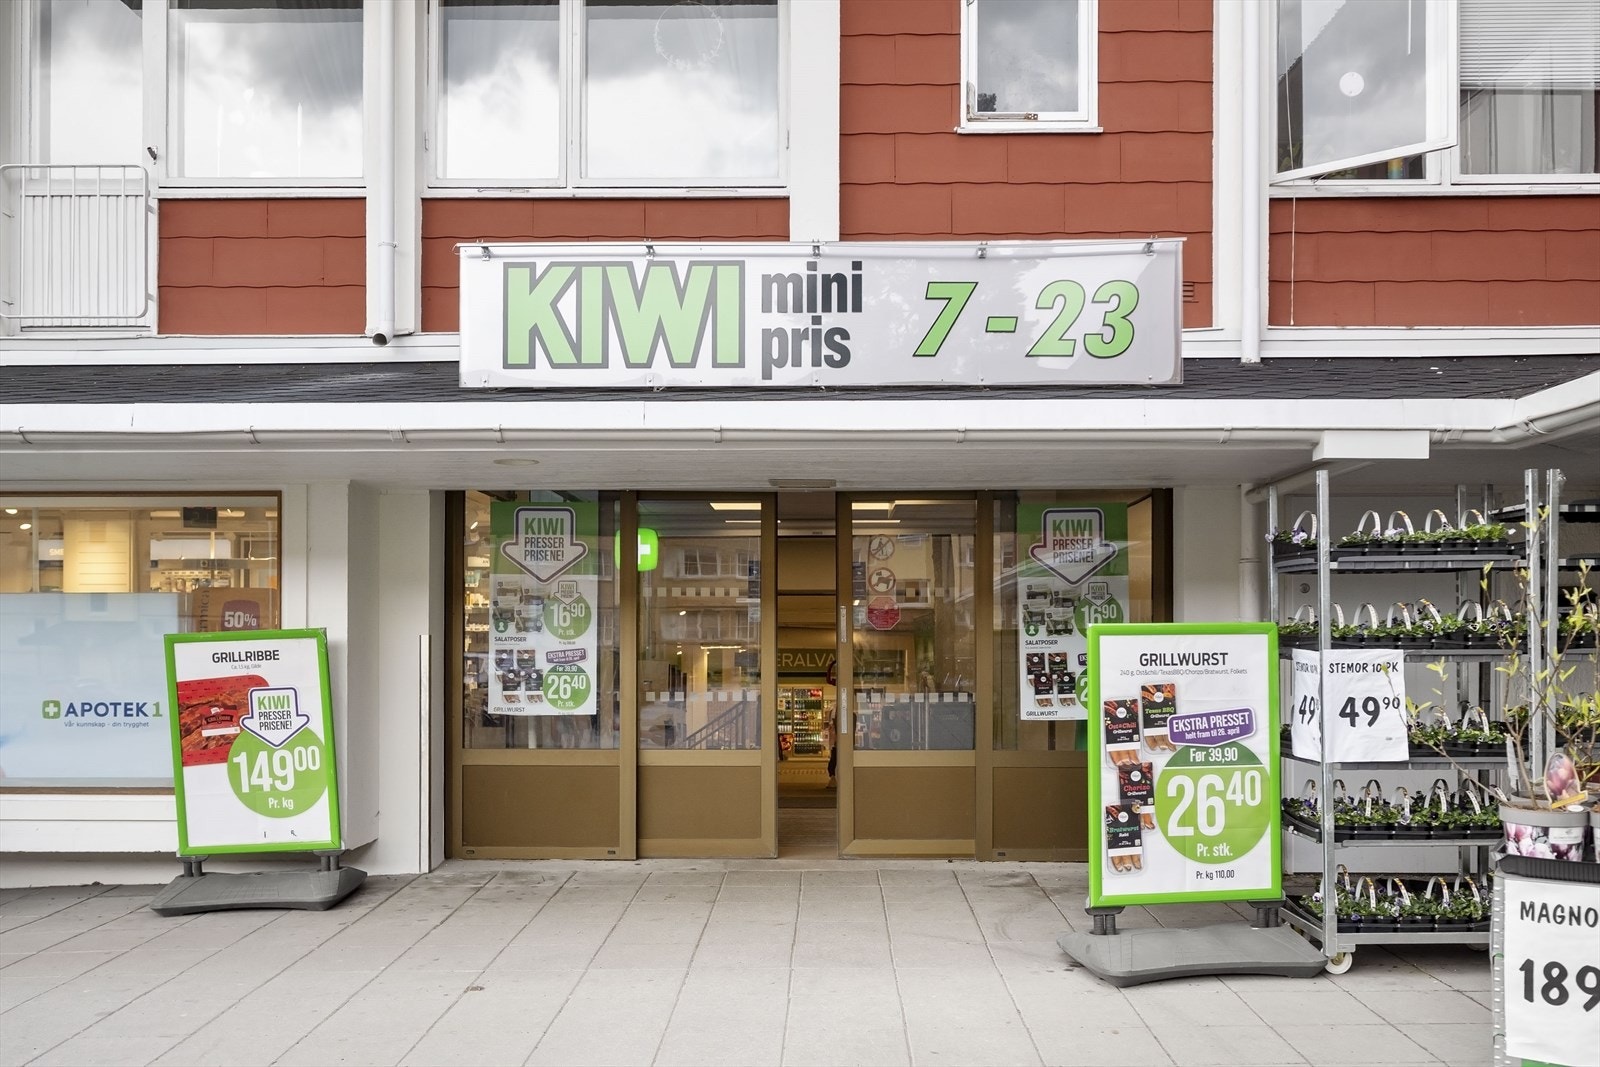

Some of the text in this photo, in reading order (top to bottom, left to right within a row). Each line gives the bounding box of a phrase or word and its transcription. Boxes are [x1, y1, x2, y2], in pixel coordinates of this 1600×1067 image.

[761, 260, 862, 314] mini
[503, 260, 745, 369] KIWI
[912, 279, 1140, 359] 7 - 23
[761, 315, 851, 380] pris
[525, 518, 564, 535] KIWI
[1052, 519, 1092, 537] KIWI
[525, 537, 564, 548] PRESSER
[1053, 538, 1093, 550] PRESSER
[525, 550, 564, 561] PRISENE!
[1053, 550, 1094, 563] PRISENE!
[224, 611, 257, 628] 50%
[212, 650, 280, 663] GRILLRIBBE
[1140, 653, 1228, 666] GRILLWURST
[1329, 663, 1368, 674] STEMOR
[64, 702, 163, 717] APOTEK 1
[257, 695, 290, 710] KIWI
[258, 710, 291, 720] PRESSER
[1173, 712, 1250, 732] EKSTRA PRESSET
[259, 720, 292, 731] PRISENE!
[1185, 732, 1196, 740] helt
[1228, 727, 1239, 735] april
[1190, 747, 1238, 763] Før 39,90
[1124, 784, 1150, 792] Chorizo
[268, 797, 294, 810] Pr. kg
[1197, 843, 1233, 857] Pr. stk.
[1196, 870, 1234, 880] Pr. kg 110,00
[1520, 901, 1599, 928] MAGNO
[1519, 958, 1600, 1012] 189
